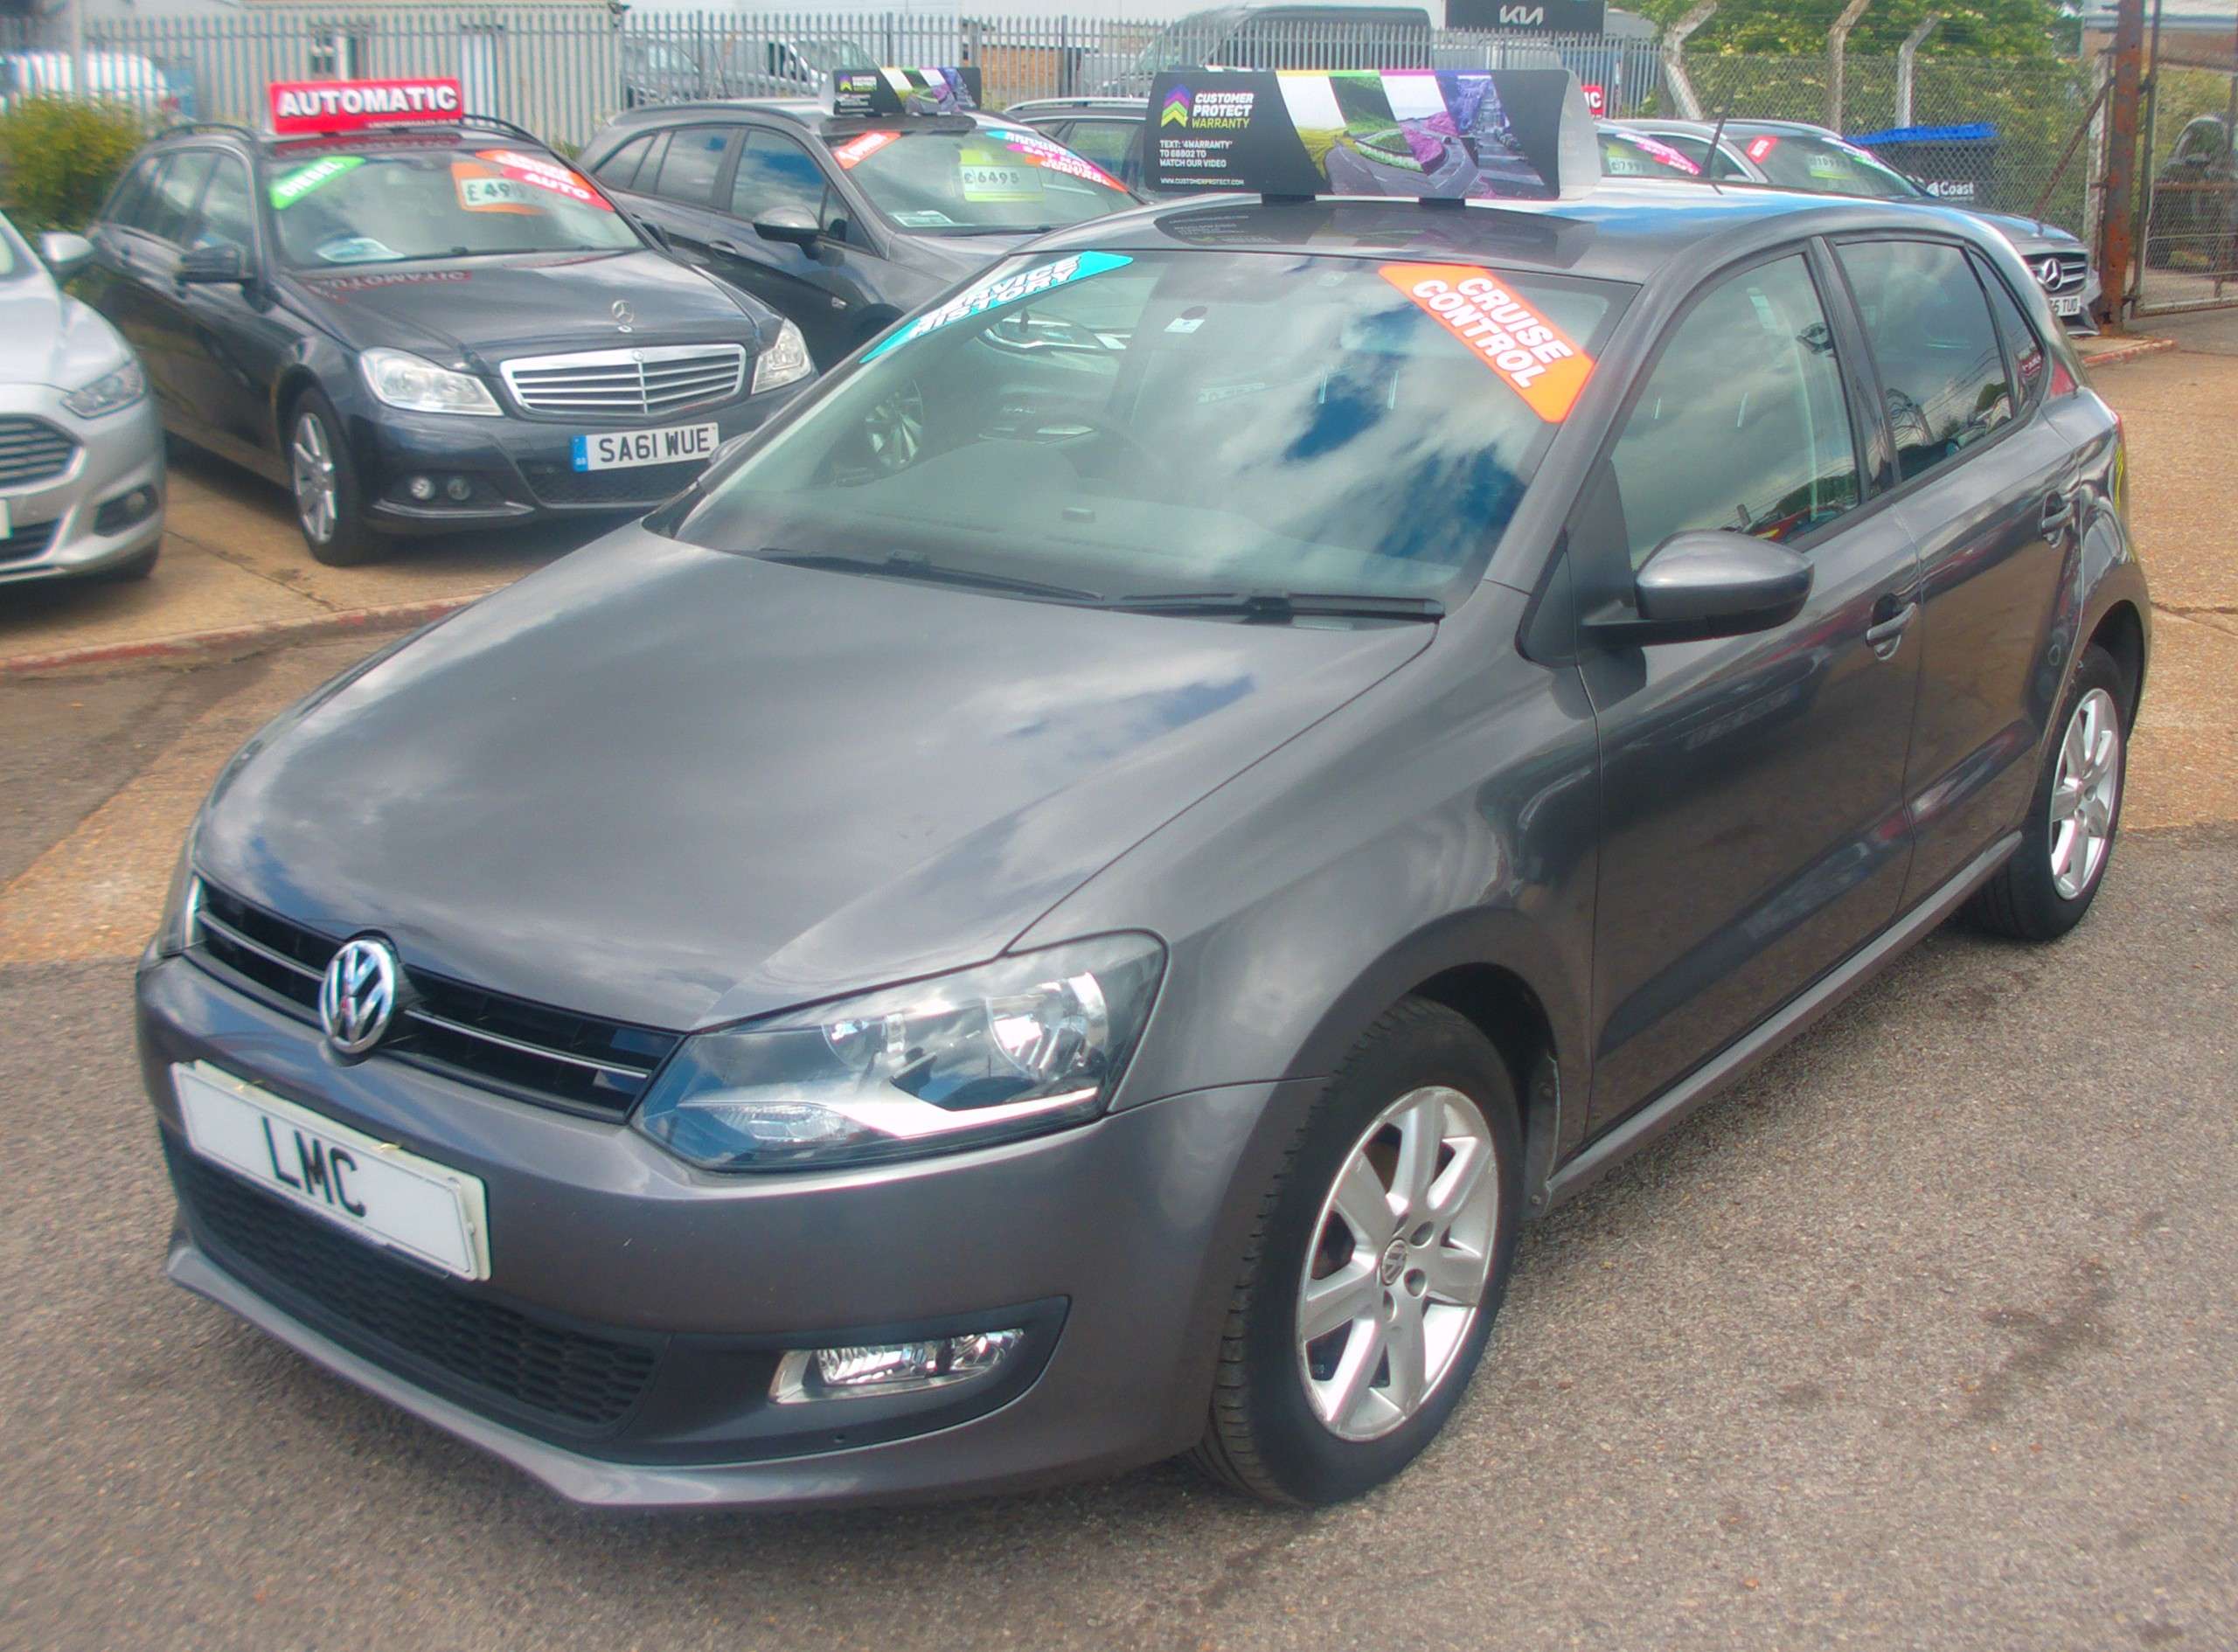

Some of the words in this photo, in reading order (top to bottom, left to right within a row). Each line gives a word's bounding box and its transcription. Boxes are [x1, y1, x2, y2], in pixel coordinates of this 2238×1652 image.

[279, 86, 458, 117] AUTOMATIC
[1194, 93, 1254, 104] CUSTOMER
[1192, 104, 1253, 116] PROTECT
[1192, 117, 1250, 128] WARRANTY
[1159, 140, 1180, 149] TEXT:
[1196, 149, 1207, 158] TO
[1186, 159, 1202, 168] OUR
[1203, 159, 1227, 168] VIDEO
[525, 173, 592, 200] AUTO
[1940, 182, 1974, 195] Coast
[1456, 277, 1574, 364] CRUISE
[1412, 280, 1546, 388] CONTROL
[599, 434, 658, 463] SA61
[665, 427, 710, 456] WUE
[261, 1115, 367, 1218] LMC
